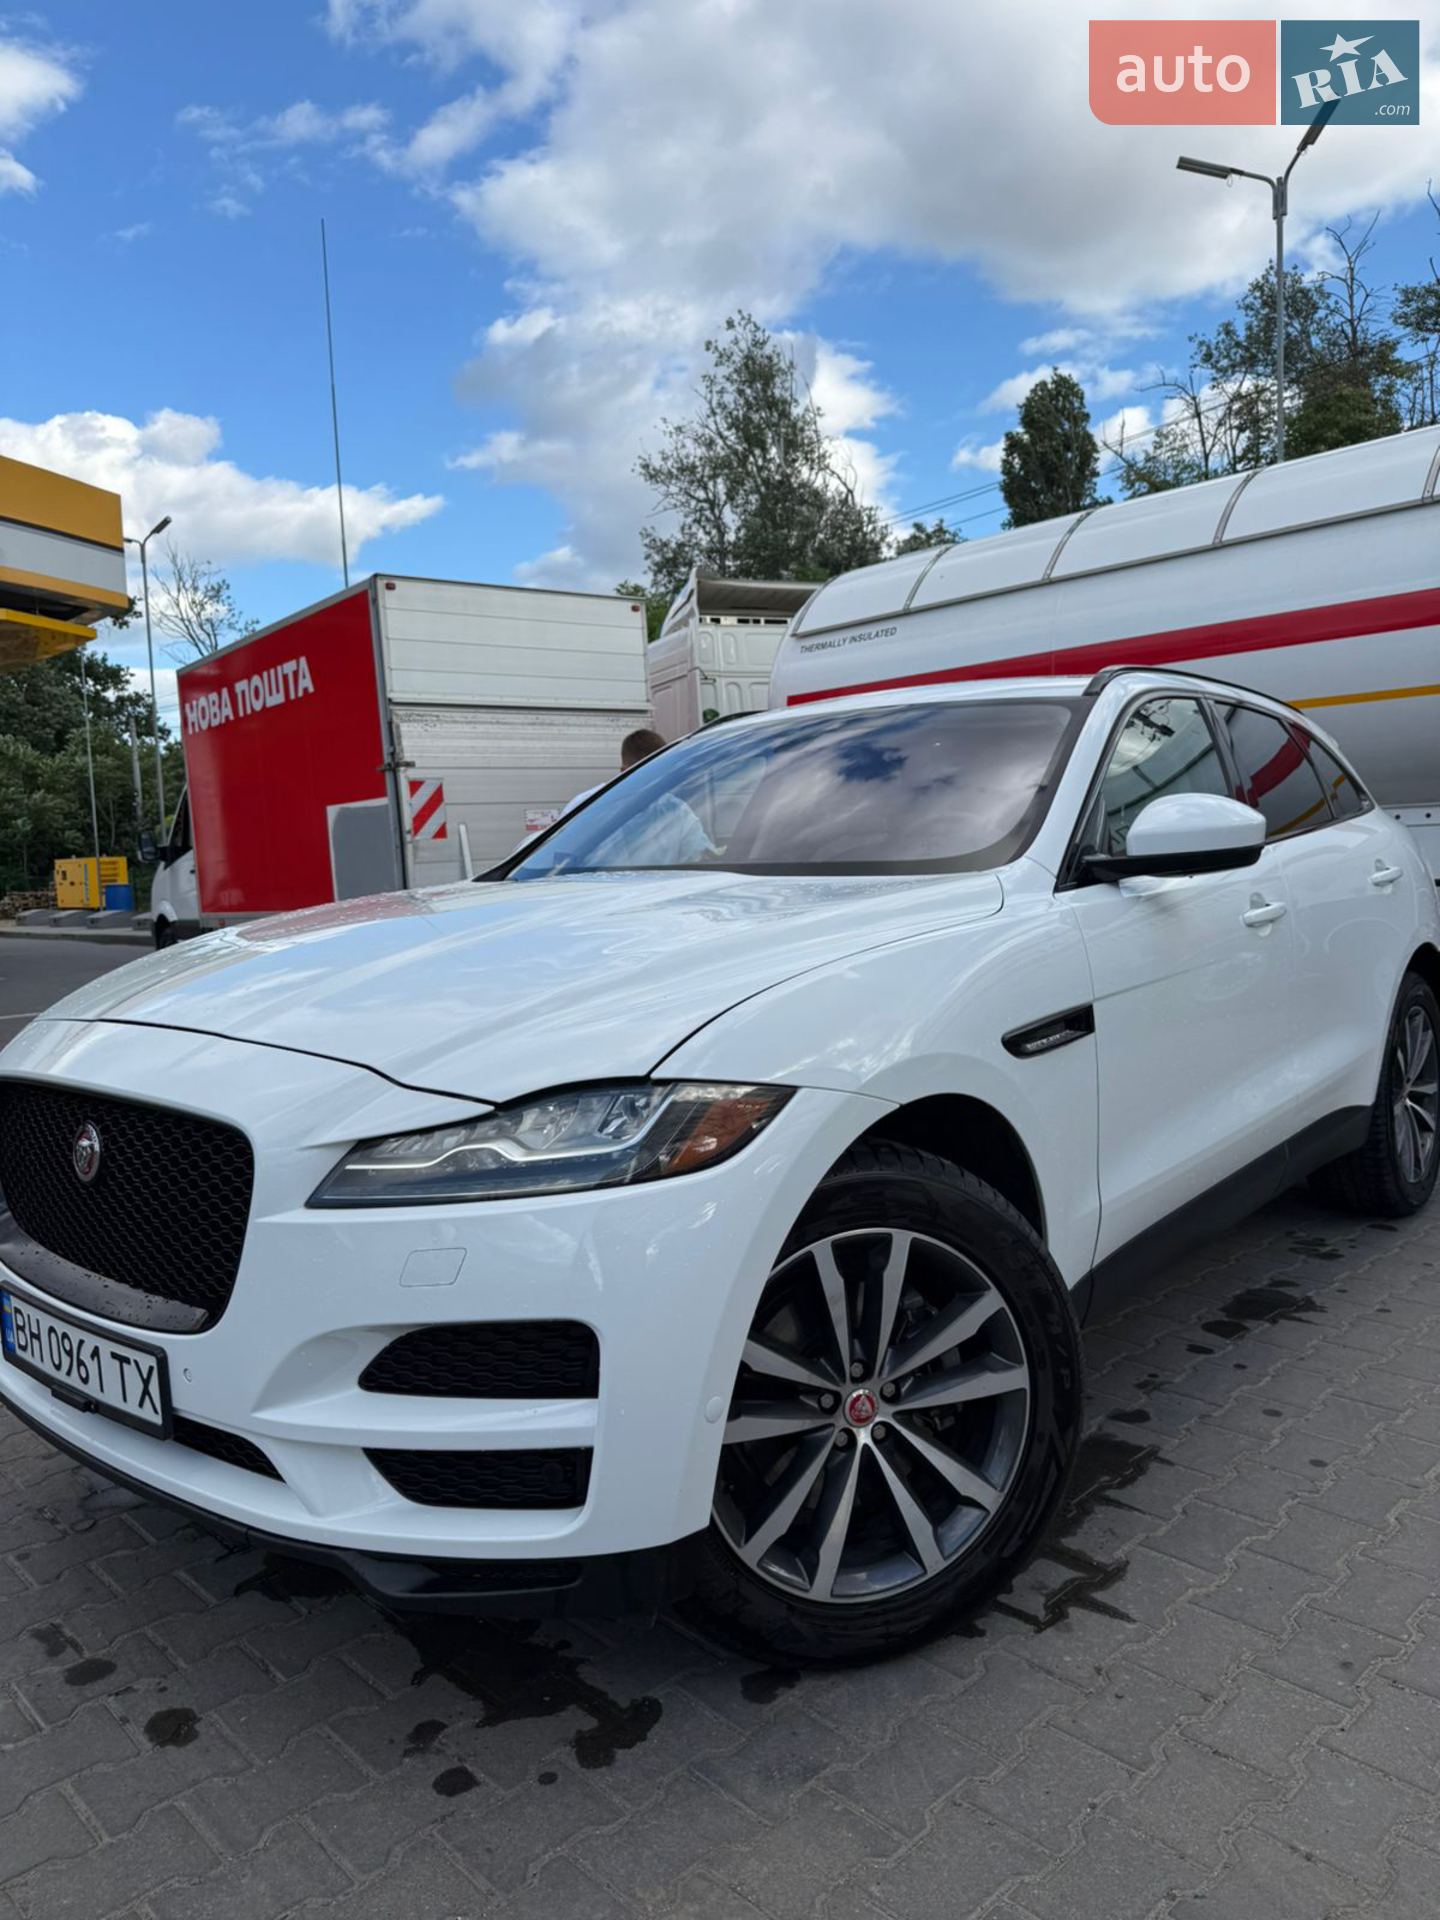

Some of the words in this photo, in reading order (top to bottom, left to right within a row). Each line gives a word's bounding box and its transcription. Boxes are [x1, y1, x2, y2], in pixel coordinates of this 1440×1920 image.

[800, 636, 848, 653] THERMALLY
[848, 626, 898, 644] INSULATED
[184, 687, 234, 735] НОВА
[234, 656, 315, 718] ПОШТА
[13, 1306, 44, 1363] BH
[47, 1325, 104, 1393] 0961
[110, 1351, 160, 1416] TX
